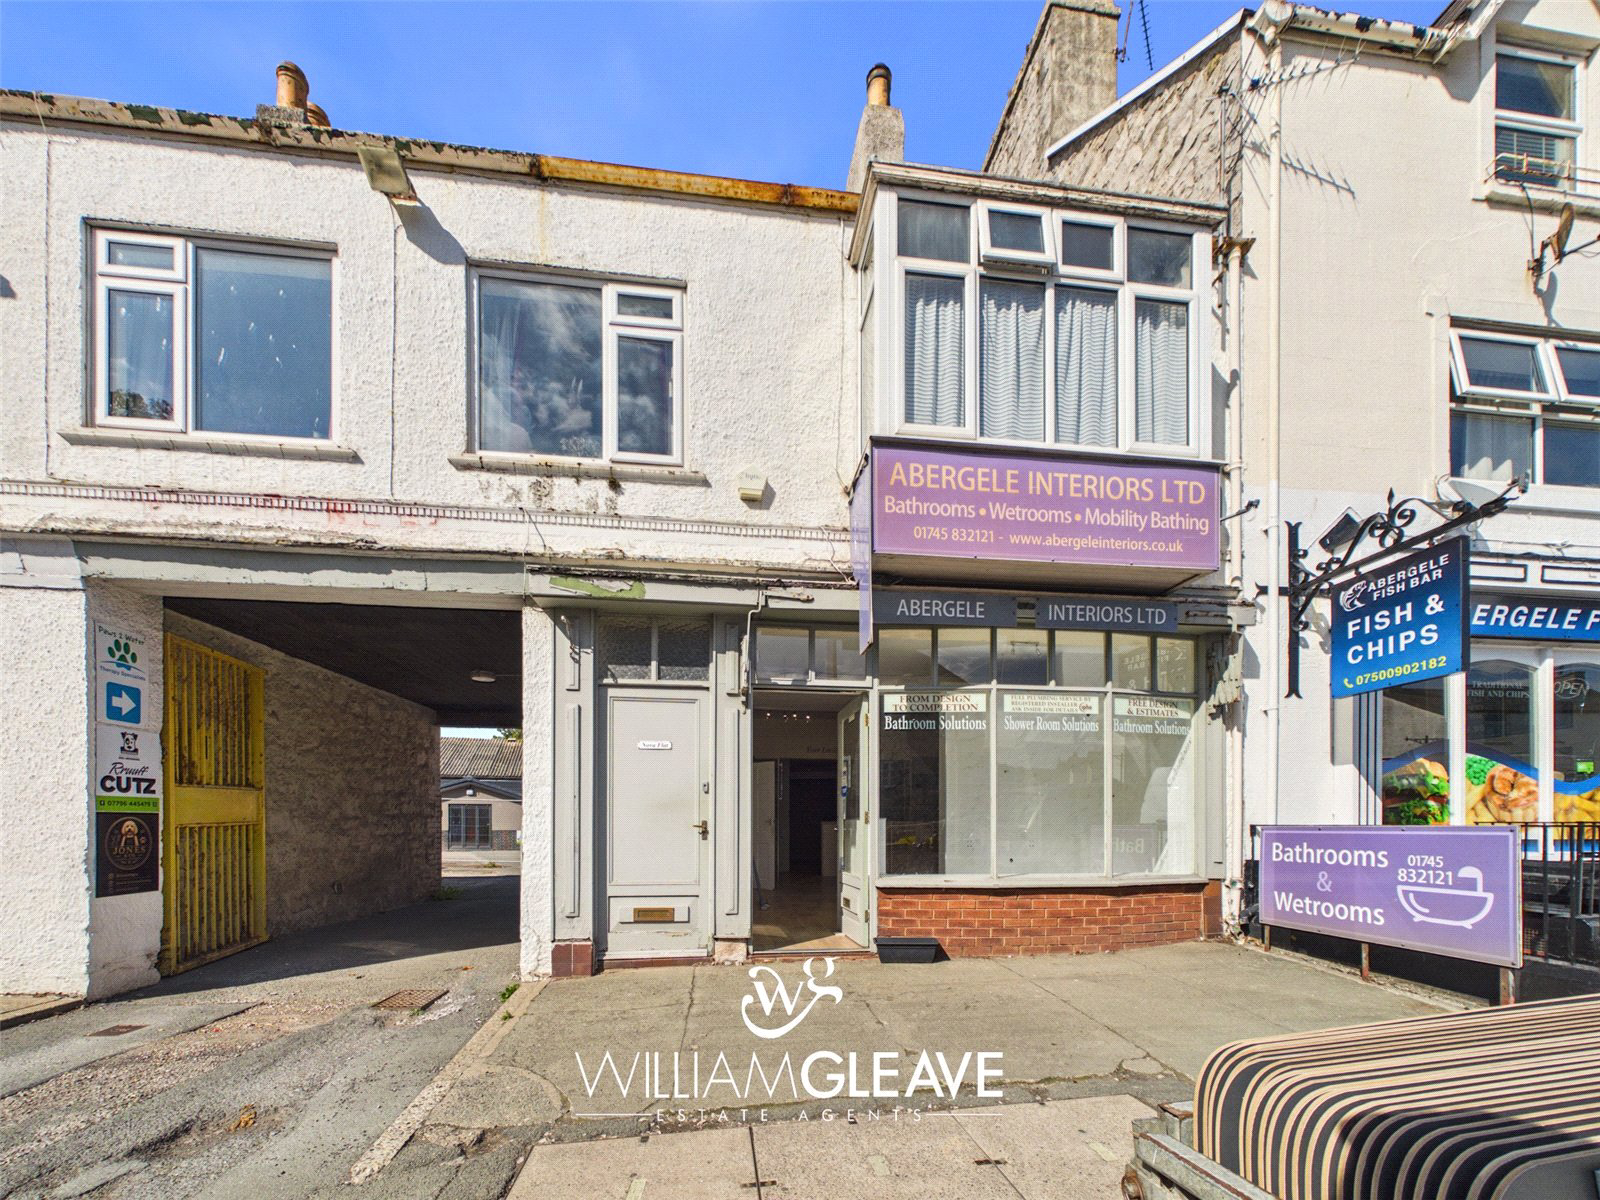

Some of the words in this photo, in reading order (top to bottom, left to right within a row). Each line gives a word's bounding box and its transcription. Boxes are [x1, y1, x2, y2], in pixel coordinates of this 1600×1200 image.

[889, 462, 1020, 494] ABERGELE
[1028, 471, 1154, 502] INTERIORS
[1161, 480, 1206, 505] LTD
[884, 495, 976, 519] Bathrooms
[989, 502, 1072, 525] Wetrooms
[1085, 508, 1148, 533] Mobility
[1151, 512, 1210, 535] Bathing
[913, 526, 949, 541] 01745
[951, 528, 995, 543] 832121
[1009, 533, 1184, 553] www.abergeleinteriors.co.uk
[1367, 554, 1450, 593] ABERGELE
[1373, 584, 1405, 601] FISH
[1410, 568, 1443, 588] BAR
[896, 599, 986, 619] ABERGELE
[1048, 604, 1134, 624] INTERIORS
[1137, 607, 1168, 625] LTD
[1347, 602, 1413, 640] FISH
[1424, 593, 1446, 616] &
[1471, 603, 1583, 630] ERGELE
[1347, 624, 1439, 665] CHIPS
[1355, 655, 1447, 687] 07500902182
[900, 695, 930, 703] FROM
[932, 694, 972, 703] DESIGN
[1487, 690, 1505, 698] AND
[893, 703, 908, 712] TO
[909, 703, 979, 712] COMPLETION
[1136, 708, 1179, 717] ESTIMATES
[884, 715, 937, 730] Bathroom
[939, 715, 987, 730] Solutions
[1004, 715, 1036, 731] Shower
[1036, 716, 1060, 731] Room
[1062, 716, 1100, 732] Solutions
[1113, 719, 1153, 733] Bathroom
[1154, 720, 1190, 735] Solutions
[100, 775, 156, 794] CUTZ
[1272, 842, 1389, 868] Bathrooms
[1407, 854, 1444, 868] 01745
[1316, 871, 1333, 893] &
[1397, 868, 1454, 886] 832121
[1274, 890, 1385, 926] Wetrooms
